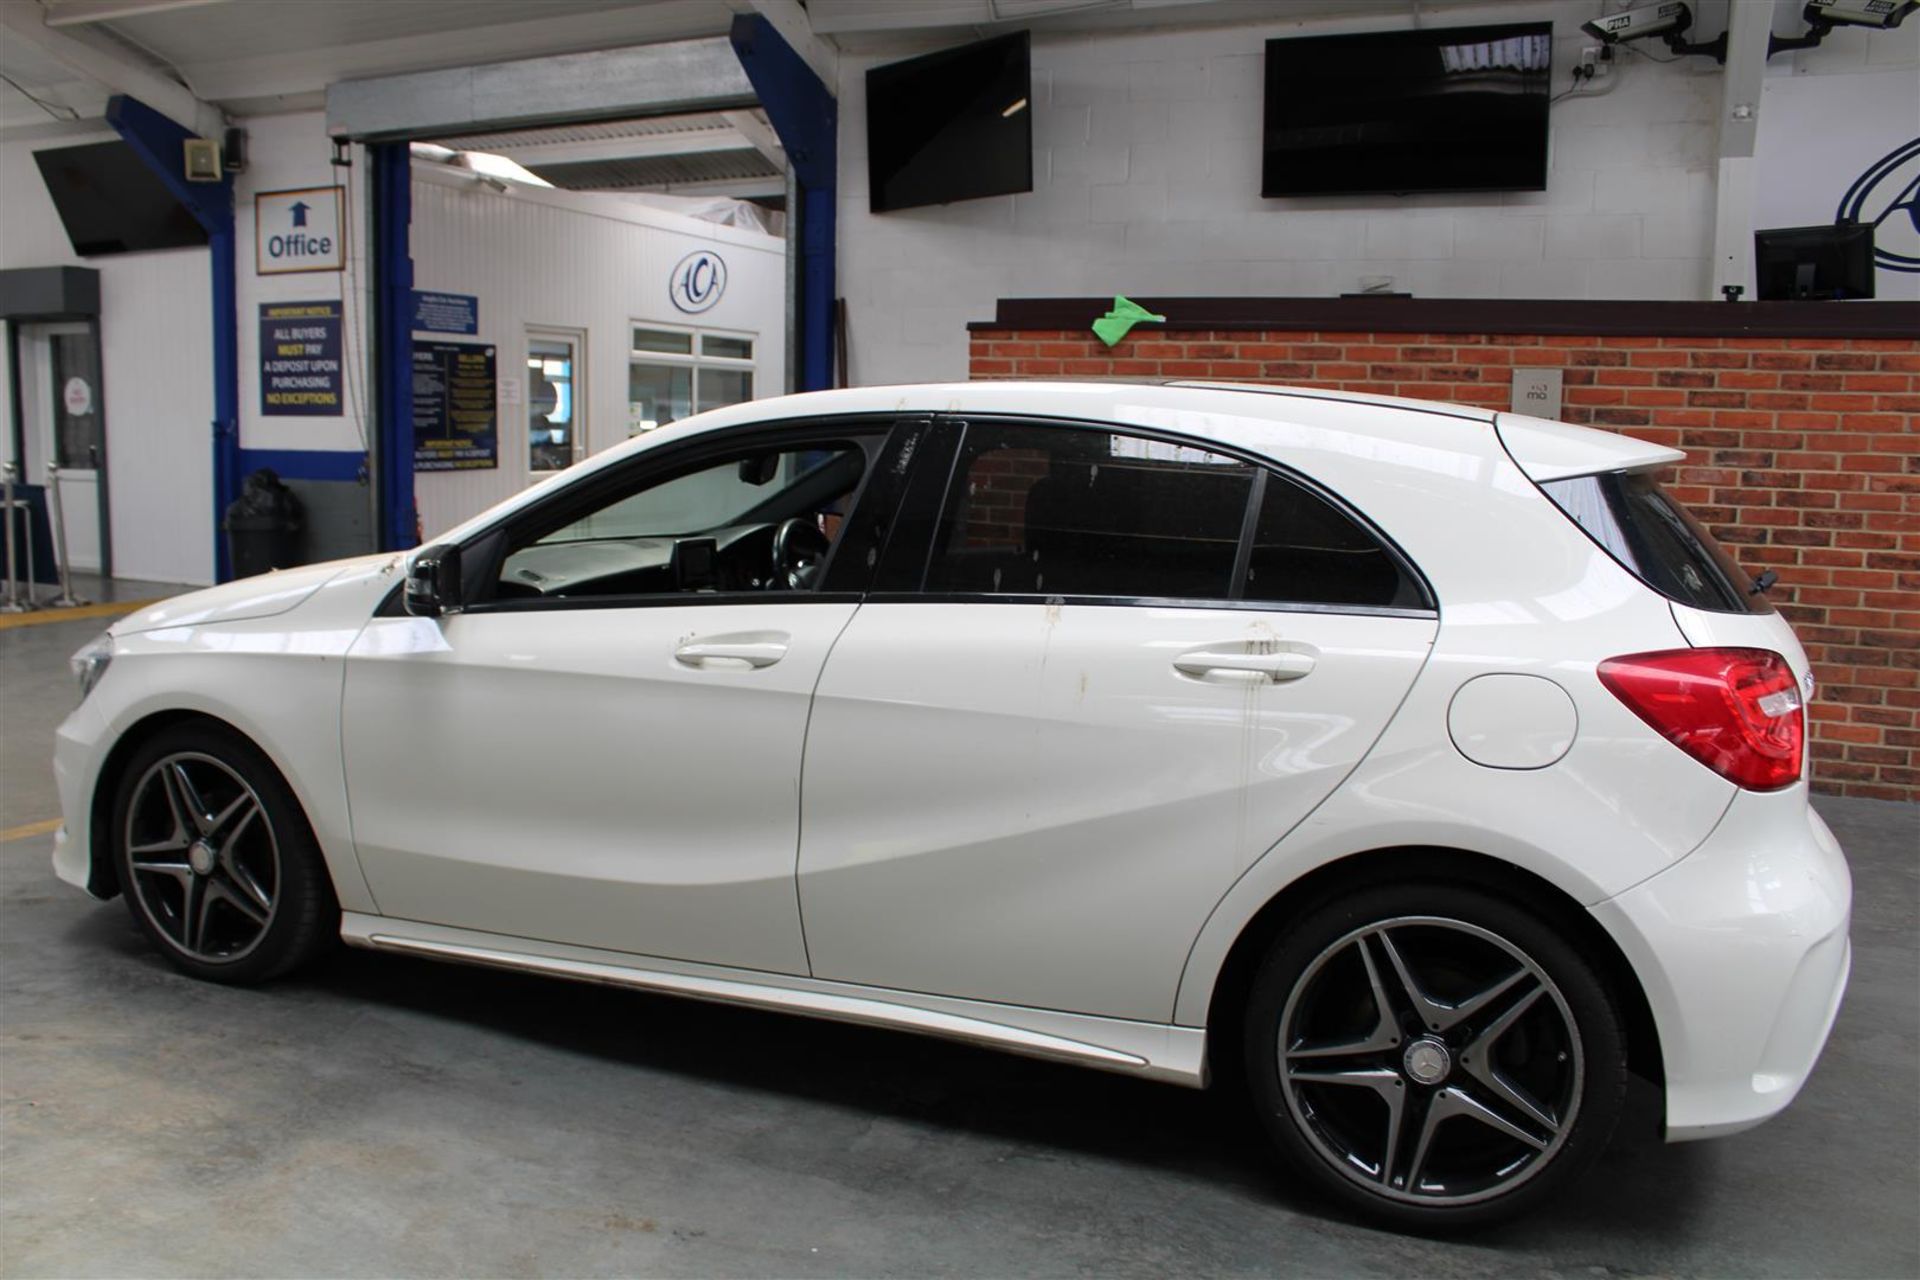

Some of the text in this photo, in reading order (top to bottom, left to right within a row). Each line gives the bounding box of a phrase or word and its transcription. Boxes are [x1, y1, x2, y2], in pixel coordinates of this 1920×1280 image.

[269, 235, 331, 257] Office
[274, 327, 326, 339] ALL BUYERS
[278, 344, 322, 355] MUST PAY
[272, 360, 309, 372] DEPOSIT
[310, 360, 338, 371] UPON
[271, 376, 330, 387] PURCHASING
[266, 393, 336, 404] NO EXCEPTIONS
